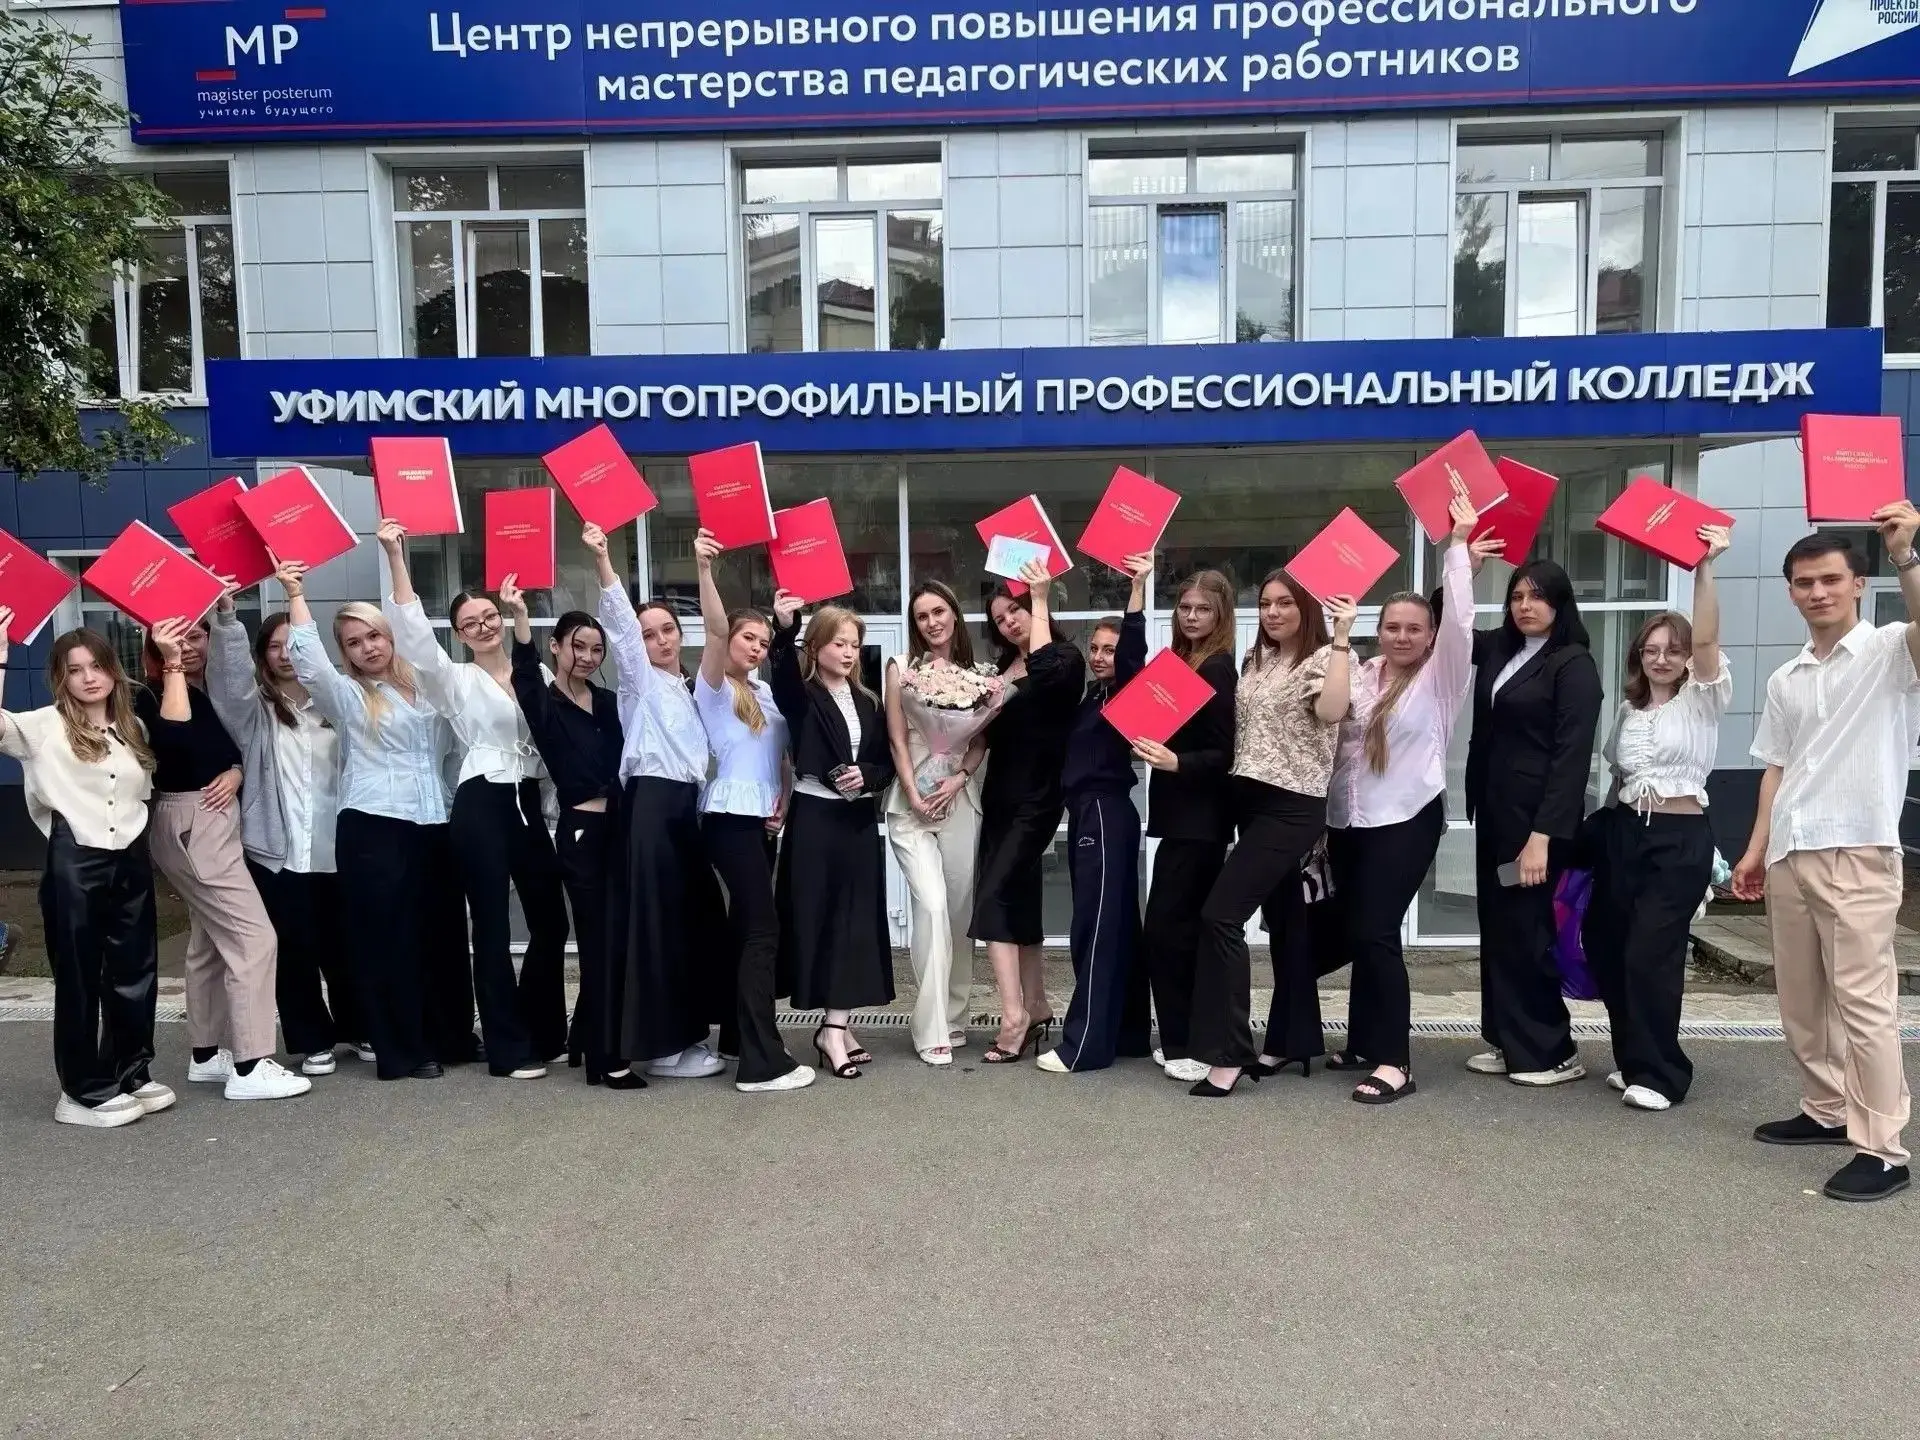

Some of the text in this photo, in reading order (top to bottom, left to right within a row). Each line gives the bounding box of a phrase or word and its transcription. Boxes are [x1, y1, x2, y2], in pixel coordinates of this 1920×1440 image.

[430, 11, 572, 61] Центр
[586, 14, 917, 59] непрерывного
[931, 3, 1197, 41] повышения
[1878, 10, 1918, 24] РОССИИ
[598, 39, 1520, 109] мастерства педагогических работников
[197, 87, 332, 104] magister posterum
[199, 104, 333, 119] учитель будущего
[269, 359, 1816, 425] УФИМСКИЙ МНОГОПРОФИЛЬНЫЙ ПРОФЕССИОНАЛЬНЫЙ КОЛЛЕДЖ
